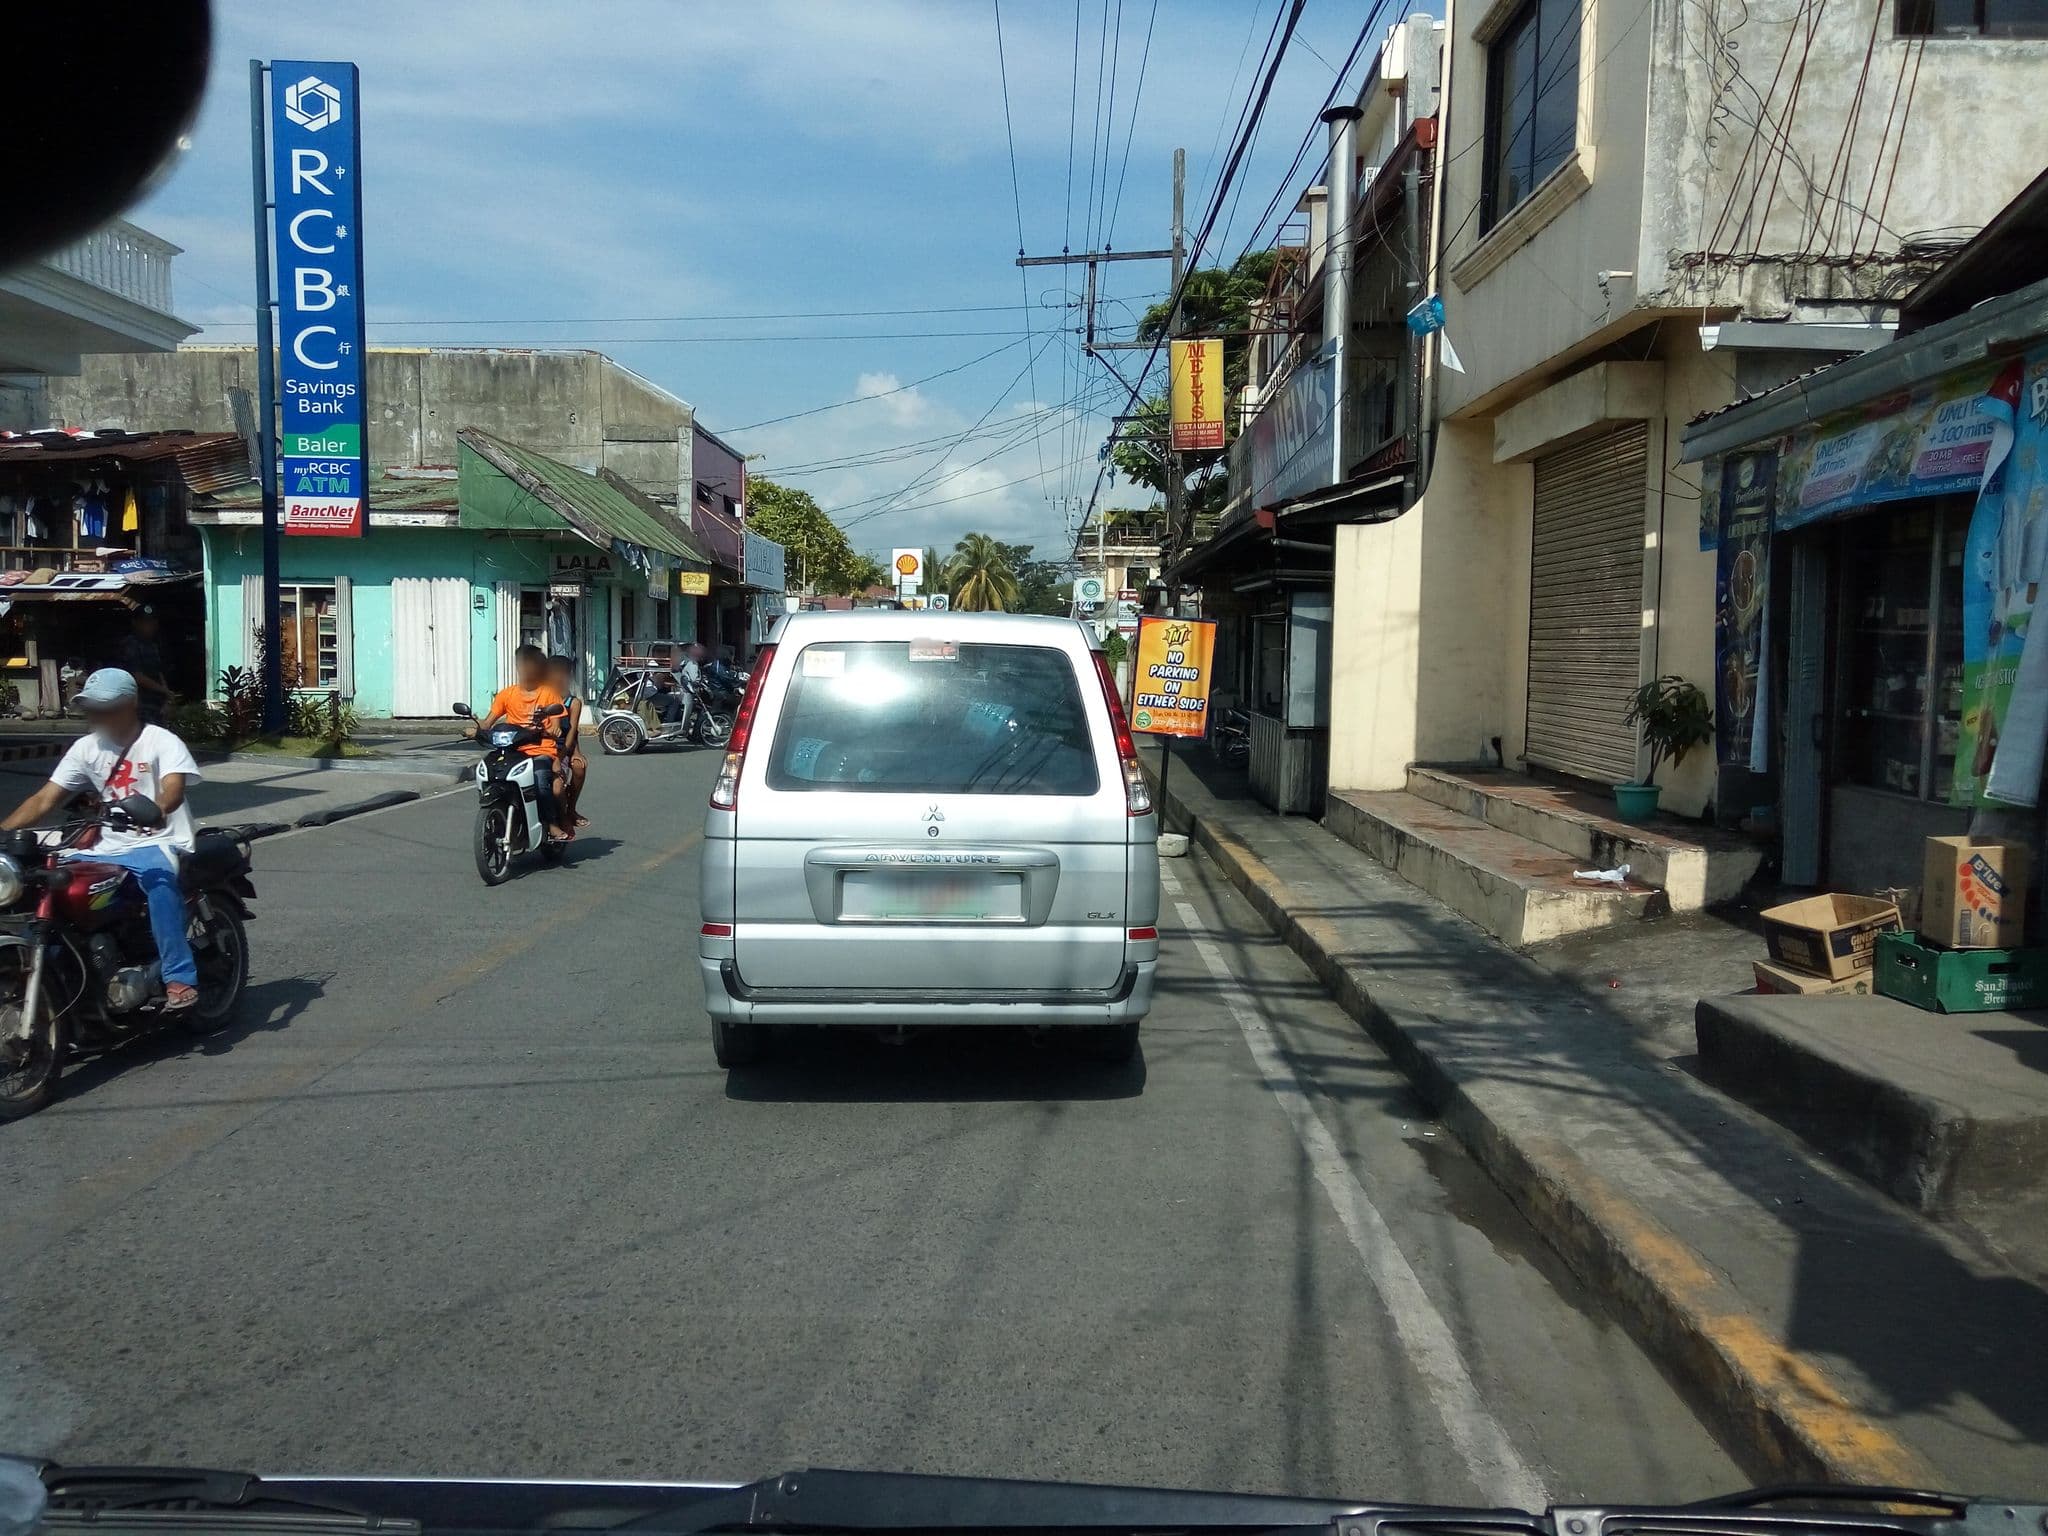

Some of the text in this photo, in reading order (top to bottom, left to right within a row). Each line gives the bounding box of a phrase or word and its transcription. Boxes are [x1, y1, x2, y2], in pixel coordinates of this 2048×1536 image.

[286, 379, 356, 398] Savings
[298, 399, 344, 414] Bank
[298, 437, 347, 452] Baler
[294, 462, 350, 477] myRCBC
[296, 476, 350, 493] ATM
[290, 504, 354, 517] BancNet
[557, 555, 611, 570] LALA
[1167, 651, 1184, 664] NO
[1149, 665, 1199, 681] PARKING
[1164, 681, 1181, 694] ON
[1137, 694, 1206, 711] EITHER SIDE
[864, 853, 1001, 864] ADVENTURE
[1087, 911, 1116, 919] GLX
[1975, 979, 1997, 992] San
